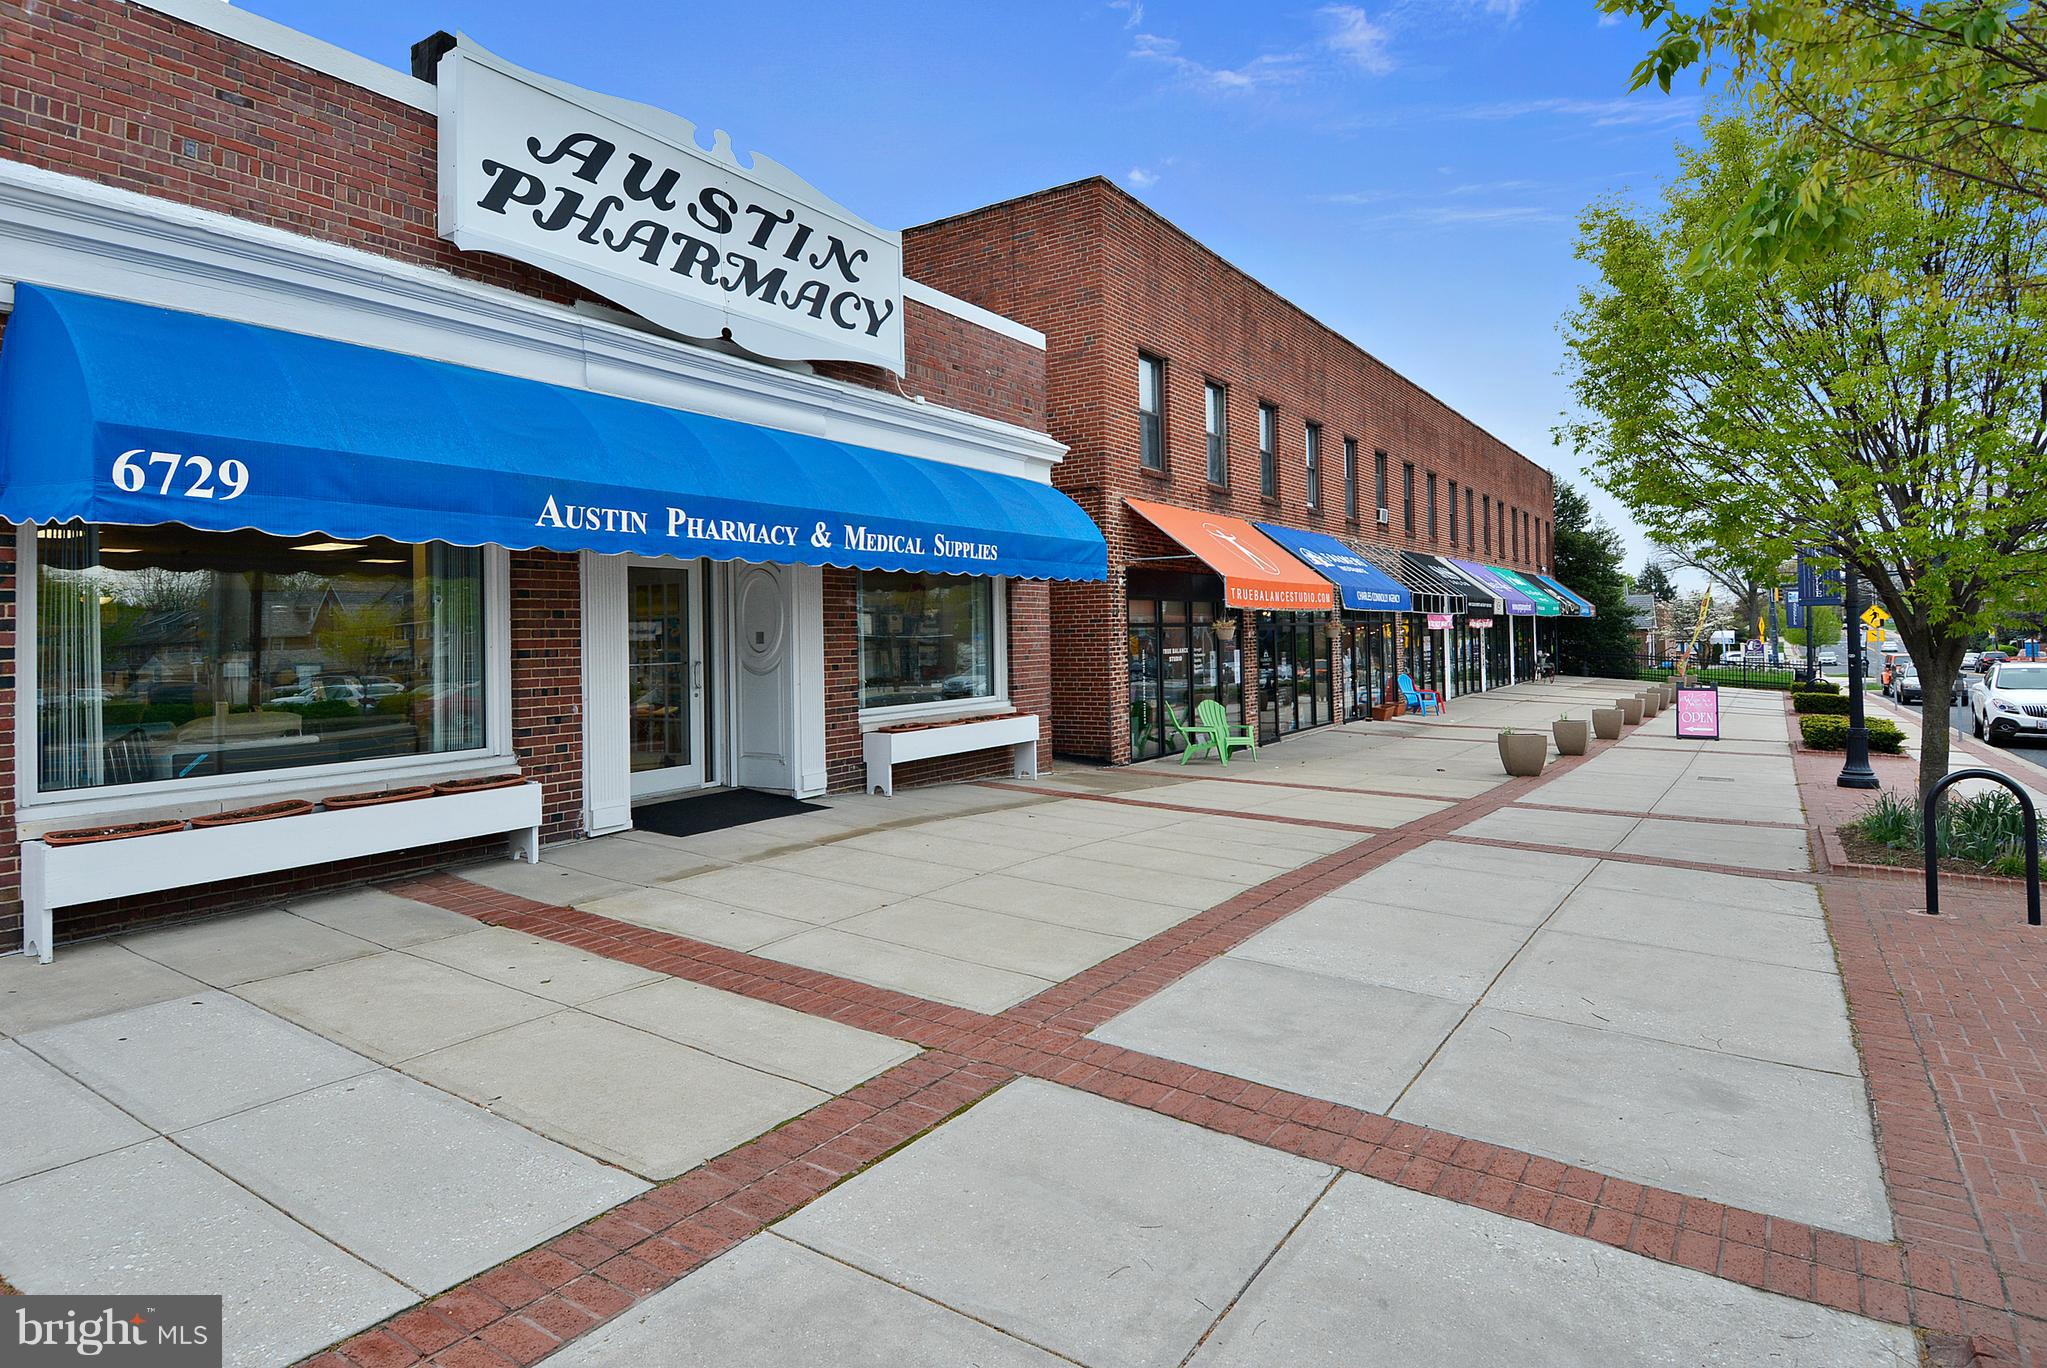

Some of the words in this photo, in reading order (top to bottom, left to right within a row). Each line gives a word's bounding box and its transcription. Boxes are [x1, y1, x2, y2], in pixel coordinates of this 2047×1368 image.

[527, 132, 868, 283] AUSTIN
[476, 158, 894, 338] PHARMACY
[111, 448, 250, 501] 6729
[535, 494, 648, 535] AUSTIN
[666, 506, 799, 547] PHARMACY
[810, 521, 832, 549] &
[844, 524, 926, 556] MEDICAL
[933, 533, 999, 562] SUPPLIES
[1230, 587, 1331, 603] TRUEBALANCESTUDIO.COM
[1681, 711, 1714, 723] OPEN
